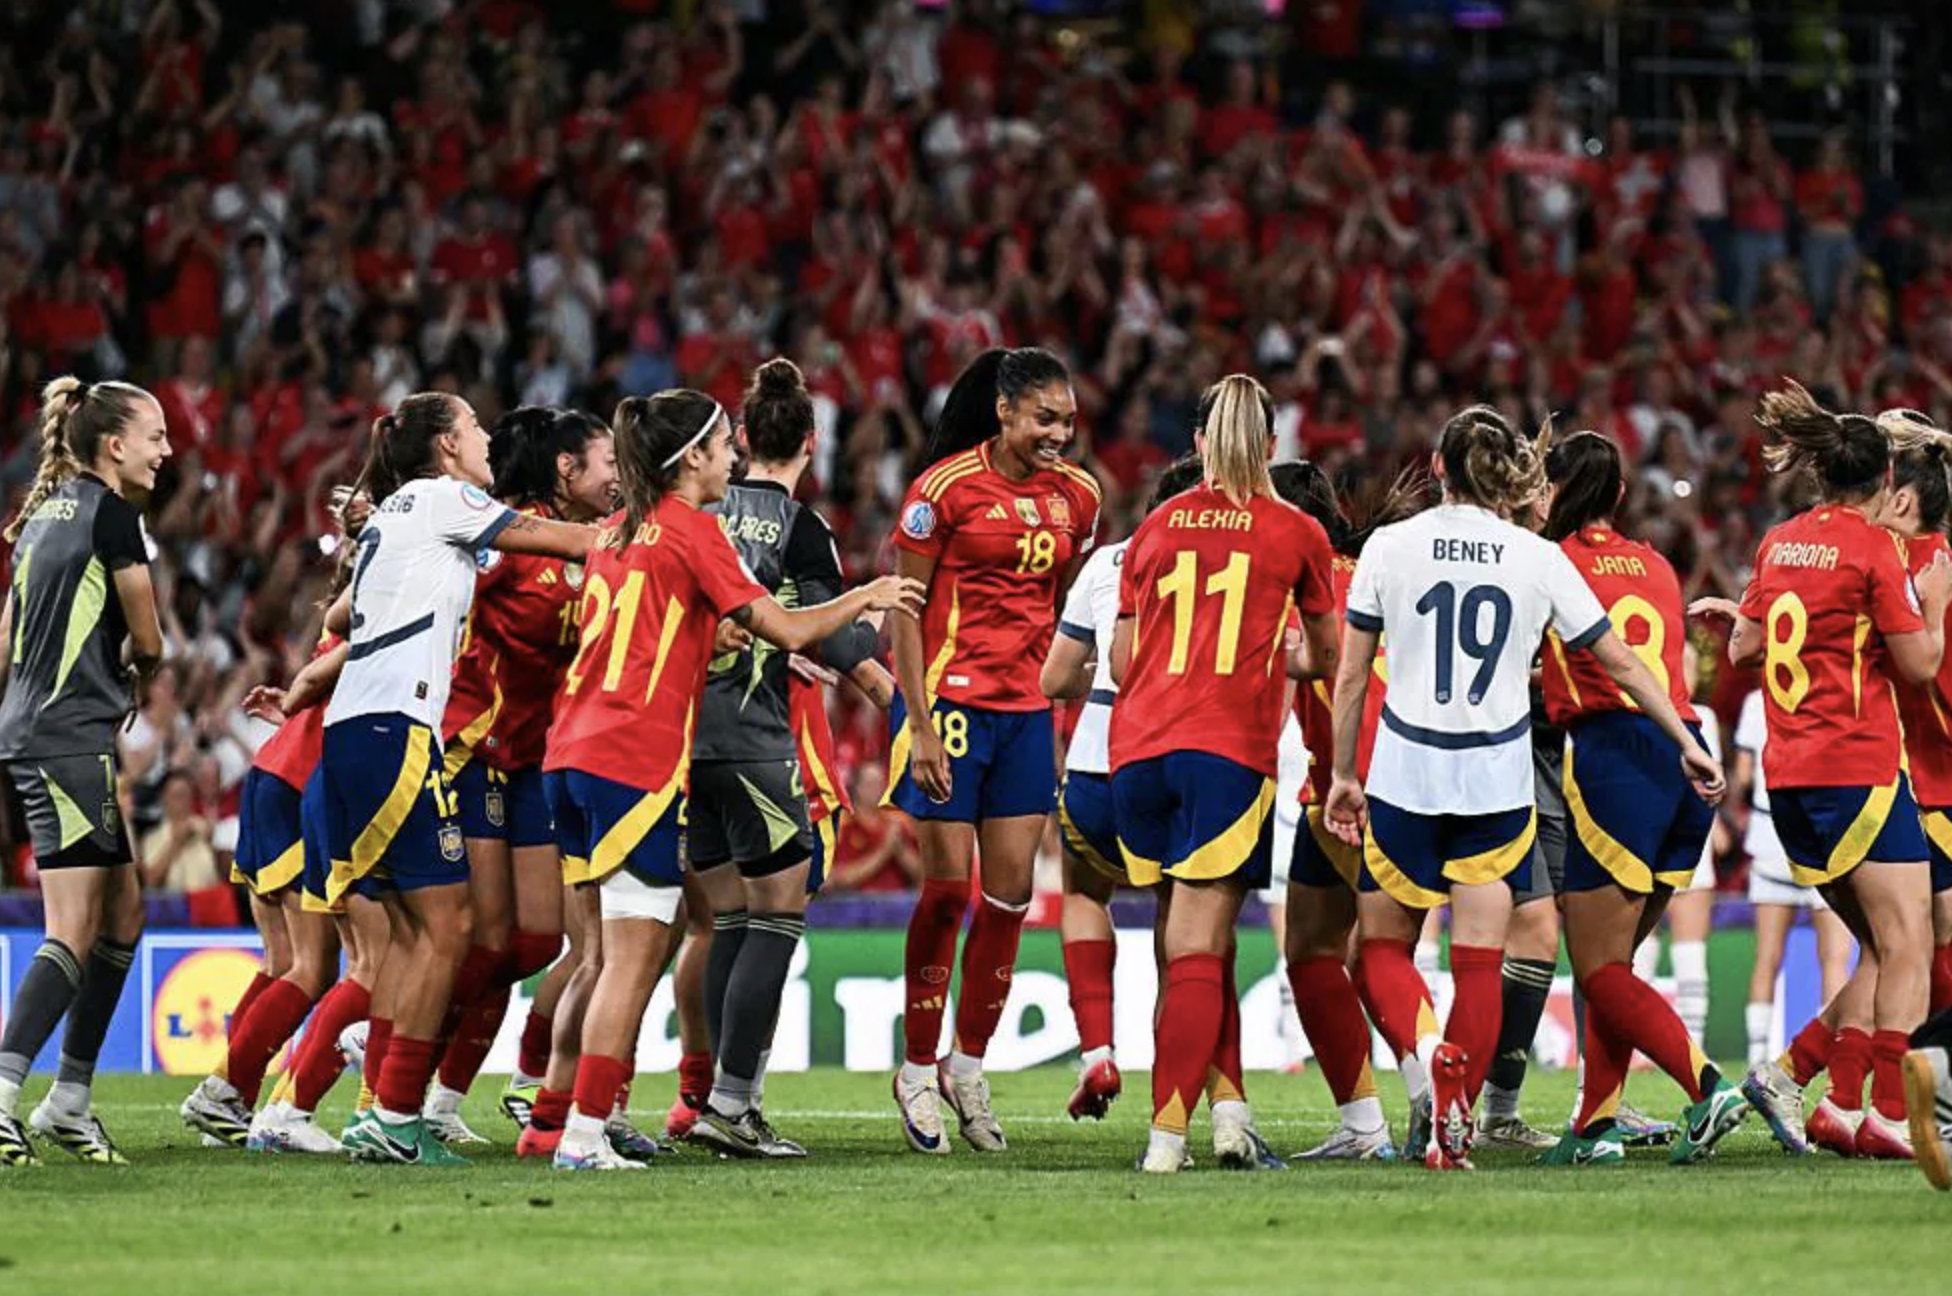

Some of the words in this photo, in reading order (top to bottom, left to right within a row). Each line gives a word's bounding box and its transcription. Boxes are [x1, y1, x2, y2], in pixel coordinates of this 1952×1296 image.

[1168, 509, 1252, 531] ALEXIA
[1016, 531, 1056, 574] 18
[1433, 538, 1504, 564] BENEY
[1591, 556, 1647, 576] JANA
[1765, 542, 1839, 571] MARIONA
[565, 570, 646, 696] 21
[1156, 550, 1251, 675] 11
[1416, 580, 1513, 705] 19
[1765, 590, 1810, 714] 8
